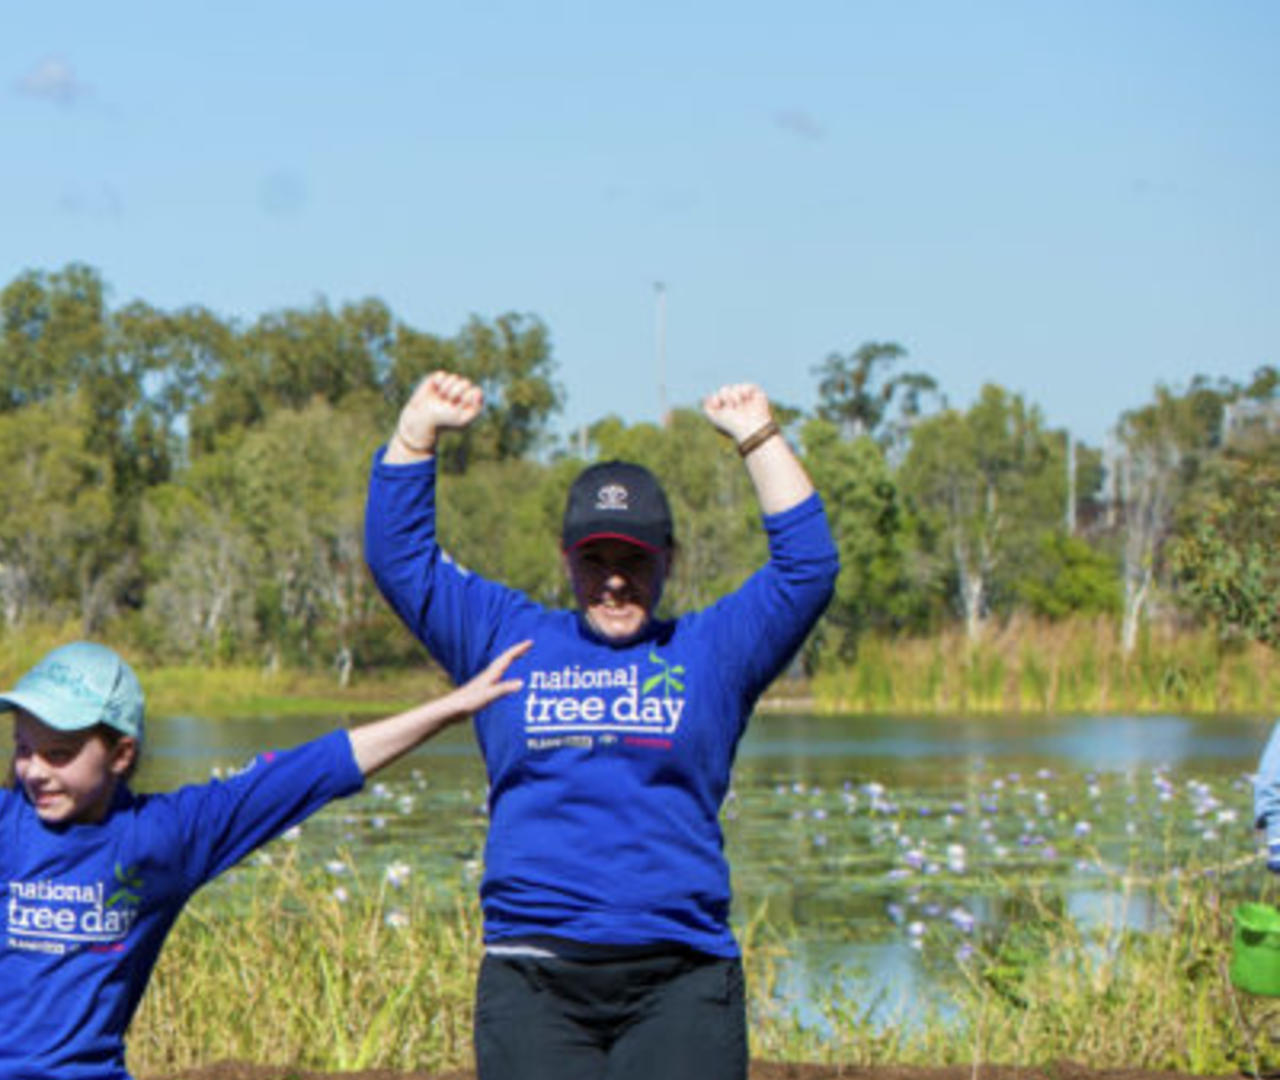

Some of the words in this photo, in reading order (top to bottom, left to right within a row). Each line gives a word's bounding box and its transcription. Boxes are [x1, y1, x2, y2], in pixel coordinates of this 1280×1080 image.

[529, 664, 638, 689] national
[525, 691, 605, 723] tree
[611, 688, 685, 734] day
[8, 879, 104, 904] national
[7, 897, 76, 932] tree
[81, 903, 137, 939] day
